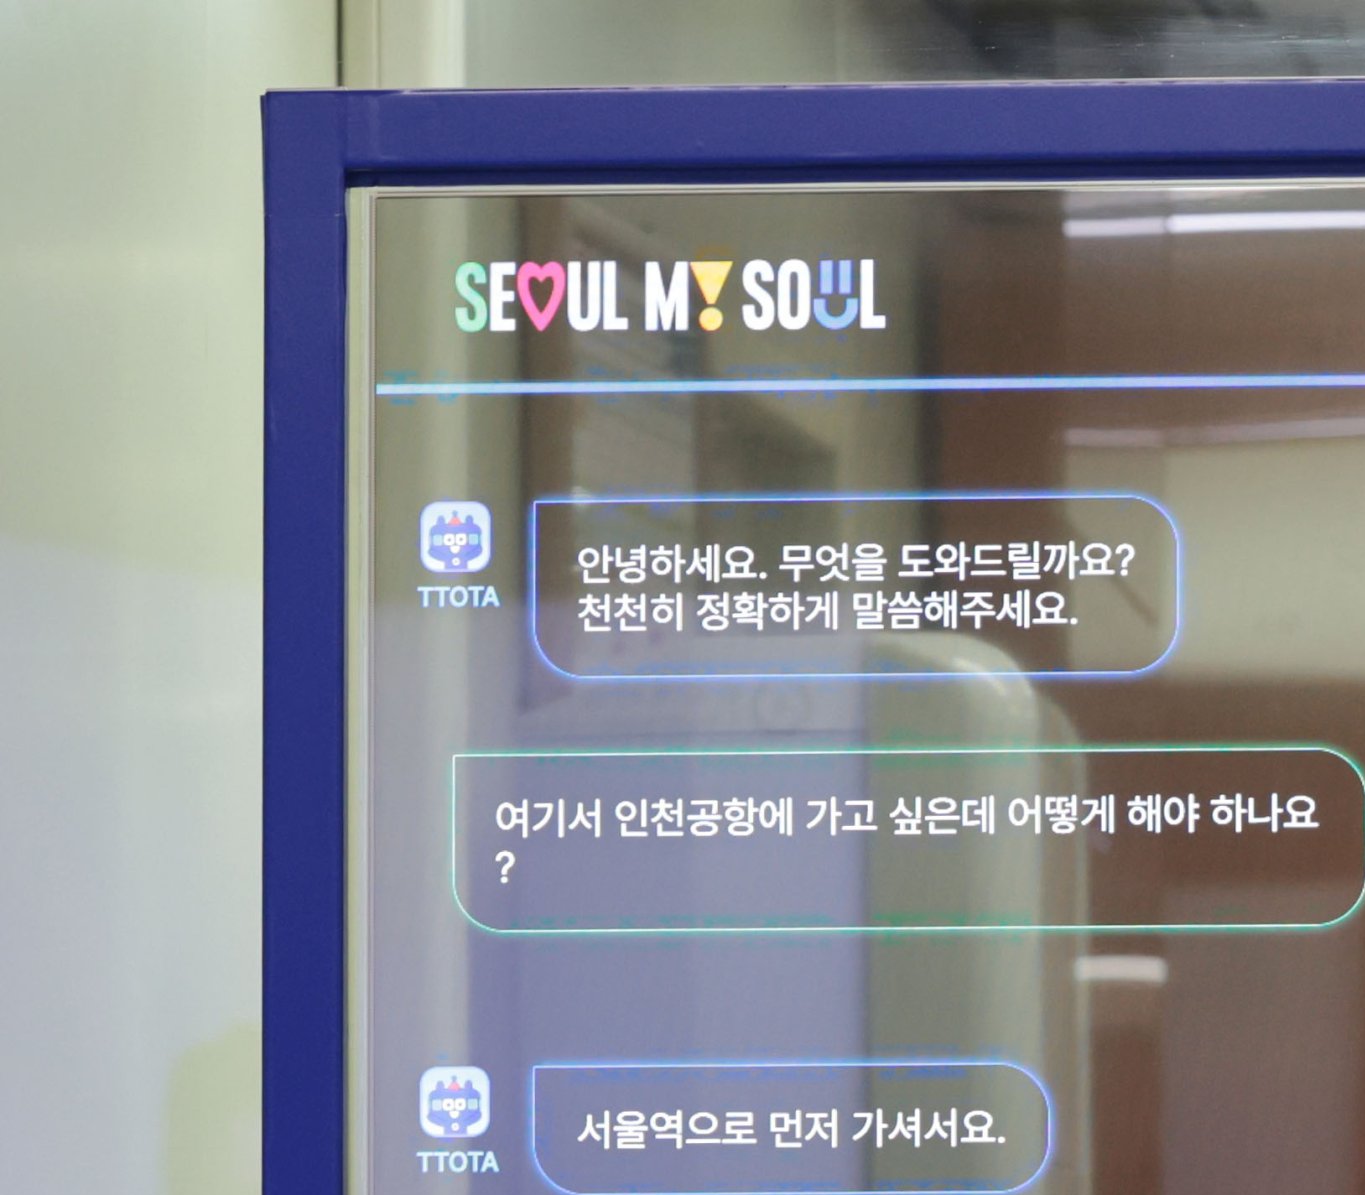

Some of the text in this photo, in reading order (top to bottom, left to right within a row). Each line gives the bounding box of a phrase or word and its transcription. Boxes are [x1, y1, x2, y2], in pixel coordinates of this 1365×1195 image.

[743, 259, 885, 330] SOUL
[578, 541, 1135, 583] 안녕하세요. 무엇을 도와드릴까요?
[418, 586, 499, 607] TTOTA
[579, 590, 1077, 631] 천천히 정확하게 말씀해주세요.
[496, 794, 1318, 838] 여기서 인천공항에 가고 싶은데 어떻게 해야 하나요
[496, 851, 515, 883] ?
[578, 1108, 1005, 1149] 서울역으로 먼저 가셔서요.
[417, 1151, 499, 1172] TTOTA
